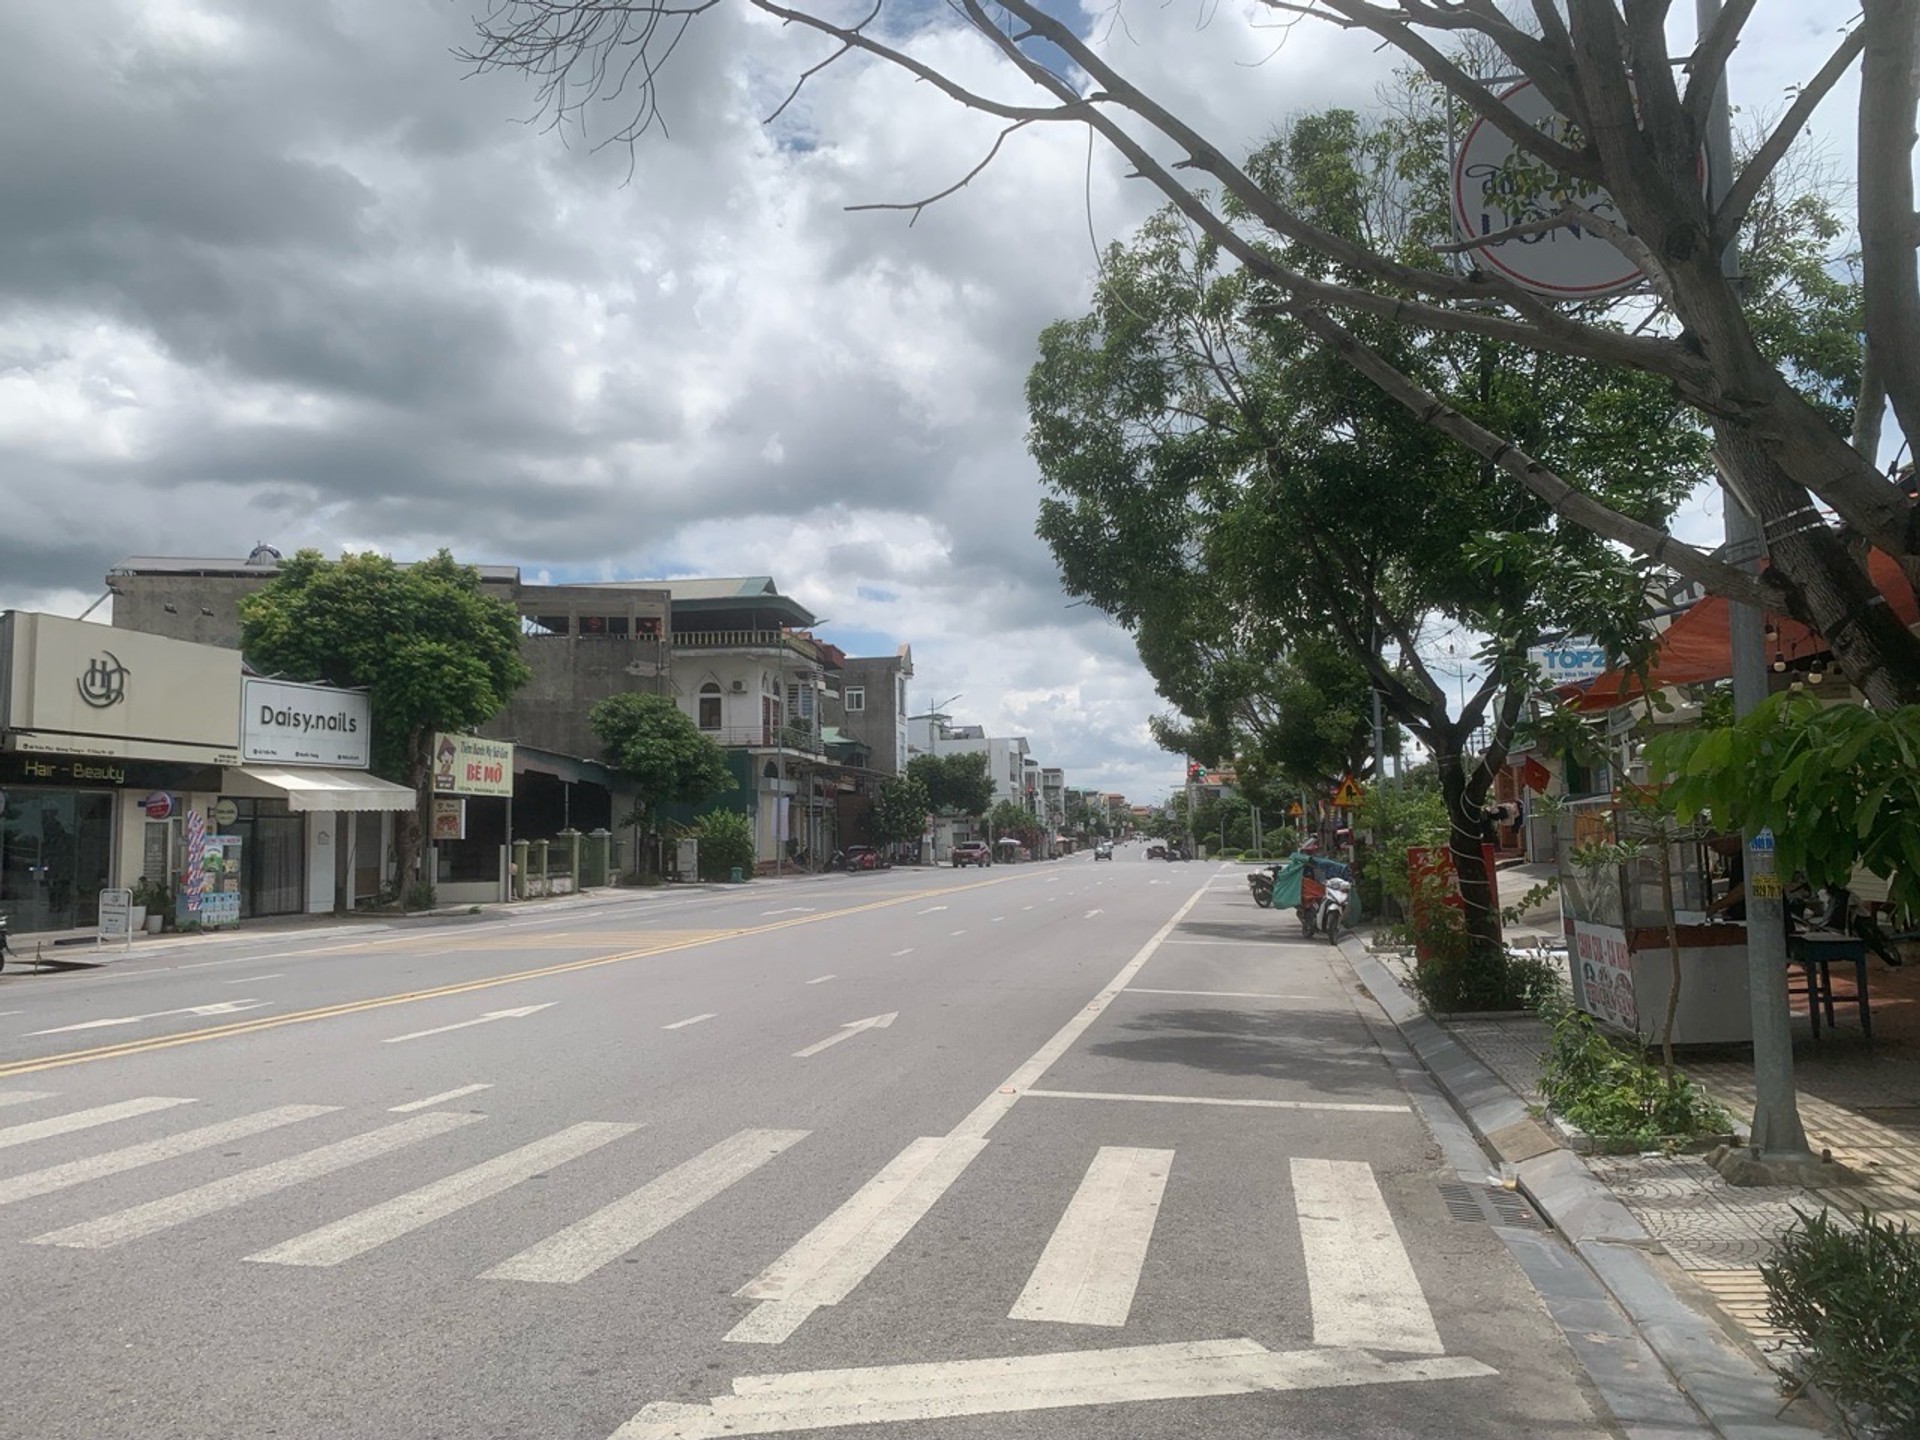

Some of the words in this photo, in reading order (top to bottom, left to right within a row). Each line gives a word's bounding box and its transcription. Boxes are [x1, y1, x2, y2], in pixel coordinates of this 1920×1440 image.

[261, 705, 357, 732] Daisy.nails
[25, 761, 57, 776] Hair
[73, 763, 125, 784] Beauty
[466, 761, 482, 781] BÉ
